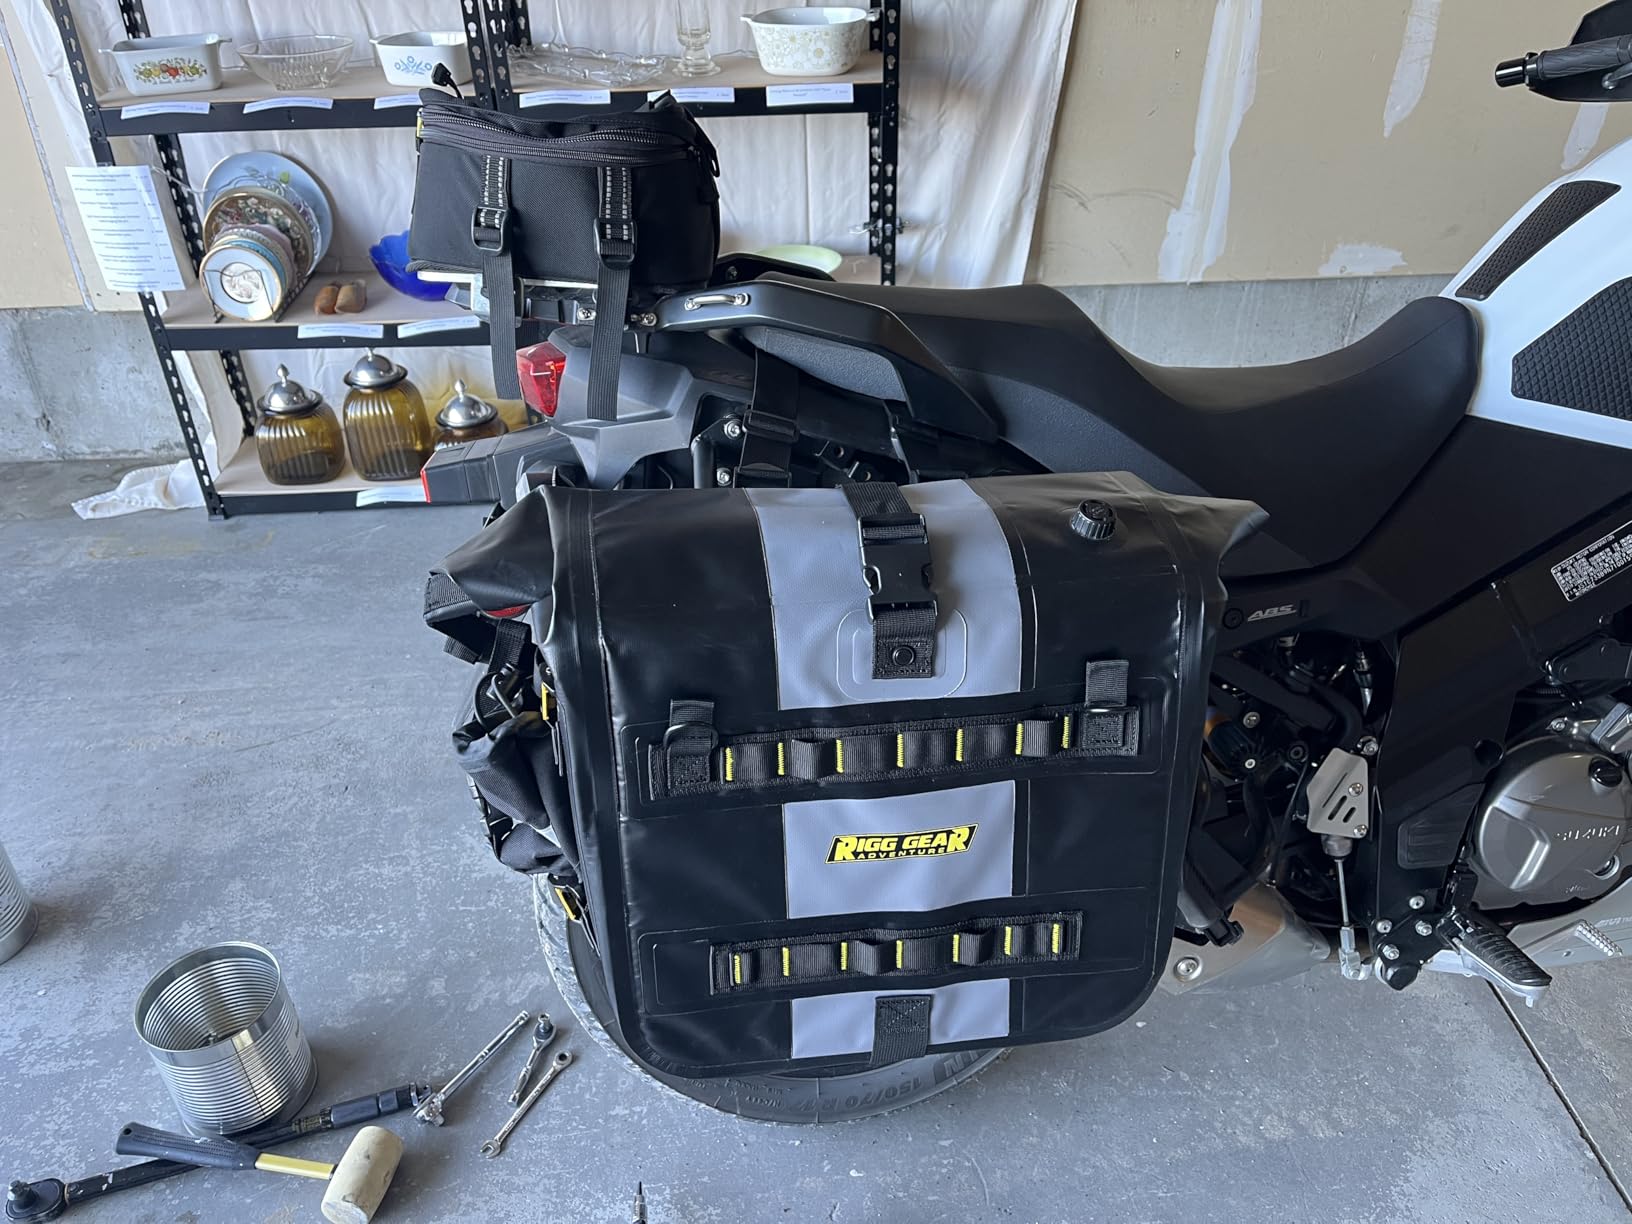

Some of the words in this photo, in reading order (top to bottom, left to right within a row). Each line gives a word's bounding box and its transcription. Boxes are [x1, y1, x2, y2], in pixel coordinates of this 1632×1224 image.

[1247, 604, 1297, 622] ABS
[834, 836, 898, 861] RIGG
[902, 827, 970, 853] GEAR
[857, 848, 945, 859] ADVENTURE
